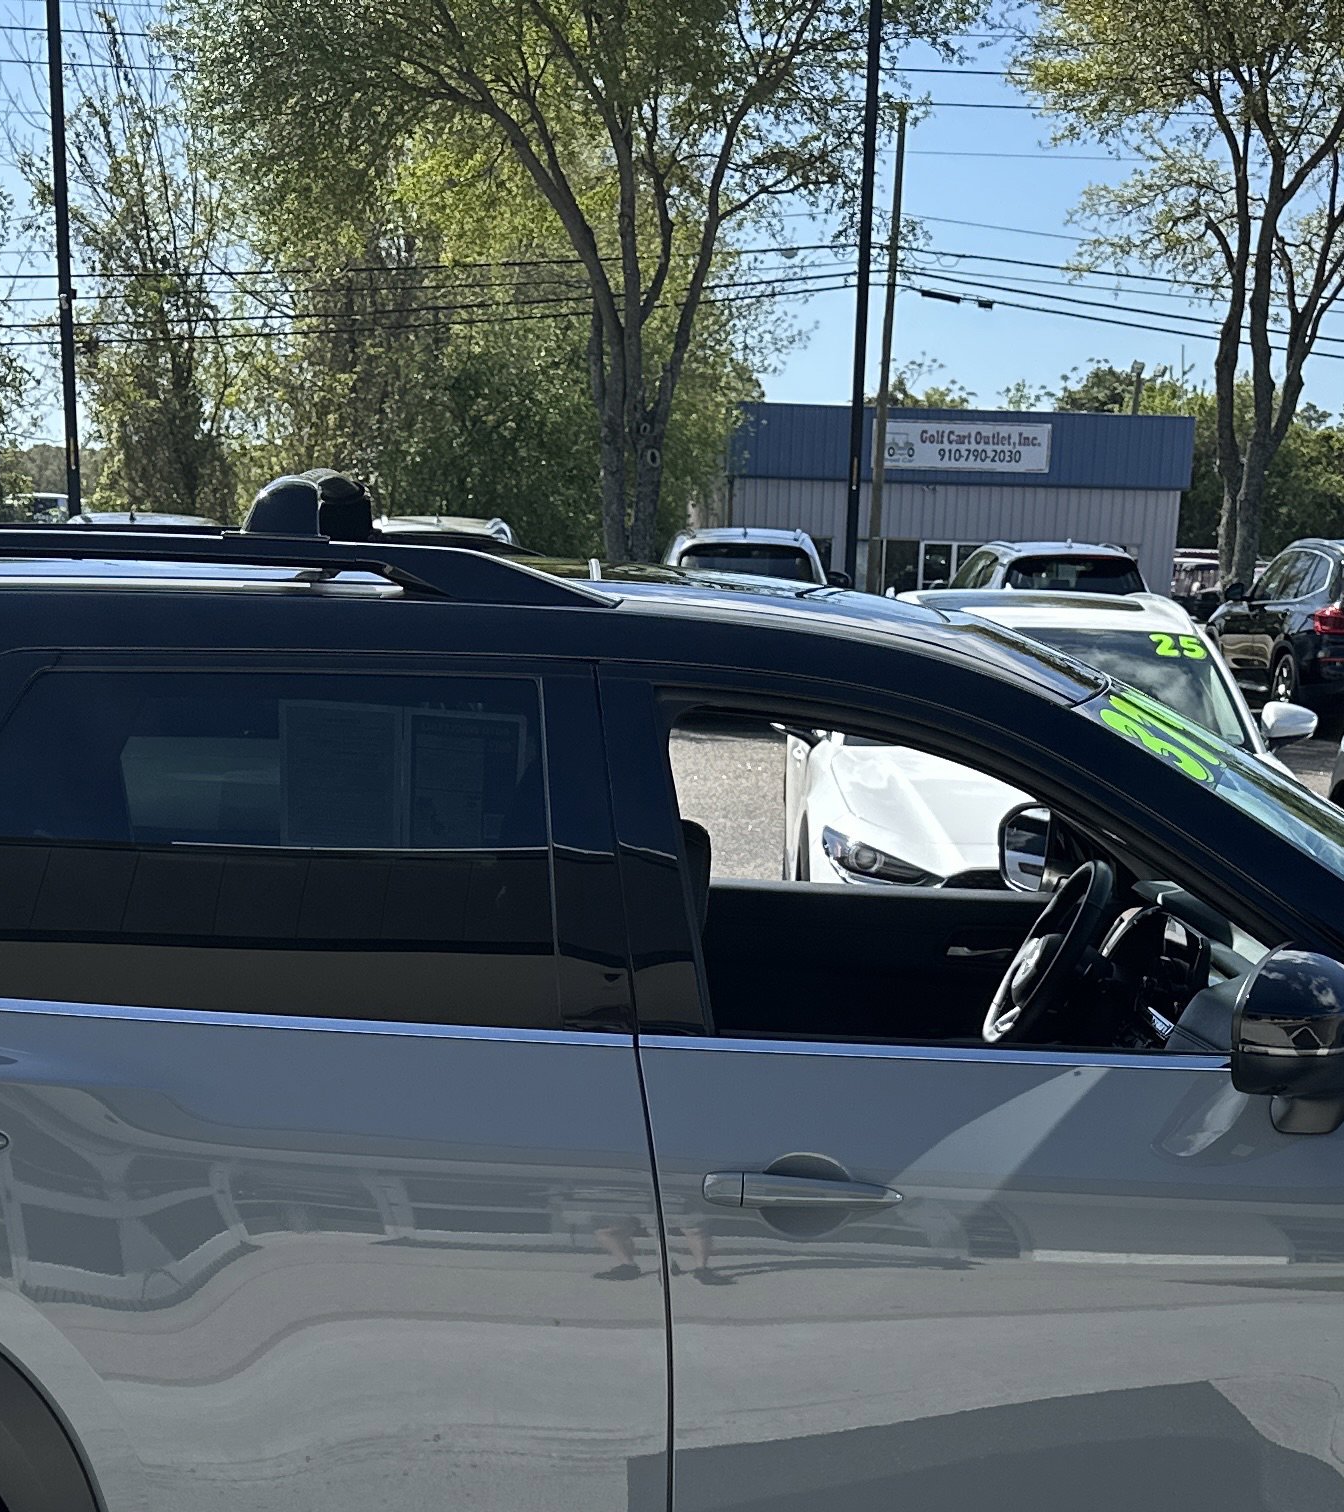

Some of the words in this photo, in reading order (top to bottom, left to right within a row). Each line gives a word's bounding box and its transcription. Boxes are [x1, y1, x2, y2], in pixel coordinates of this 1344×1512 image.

[920, 430, 945, 444] Golf
[947, 431, 972, 445] Cart
[974, 431, 1017, 449] Outlet,
[1018, 432, 1042, 447] Inc.
[938, 448, 1022, 463] 910-790-2030
[1149, 634, 1207, 660] 25
